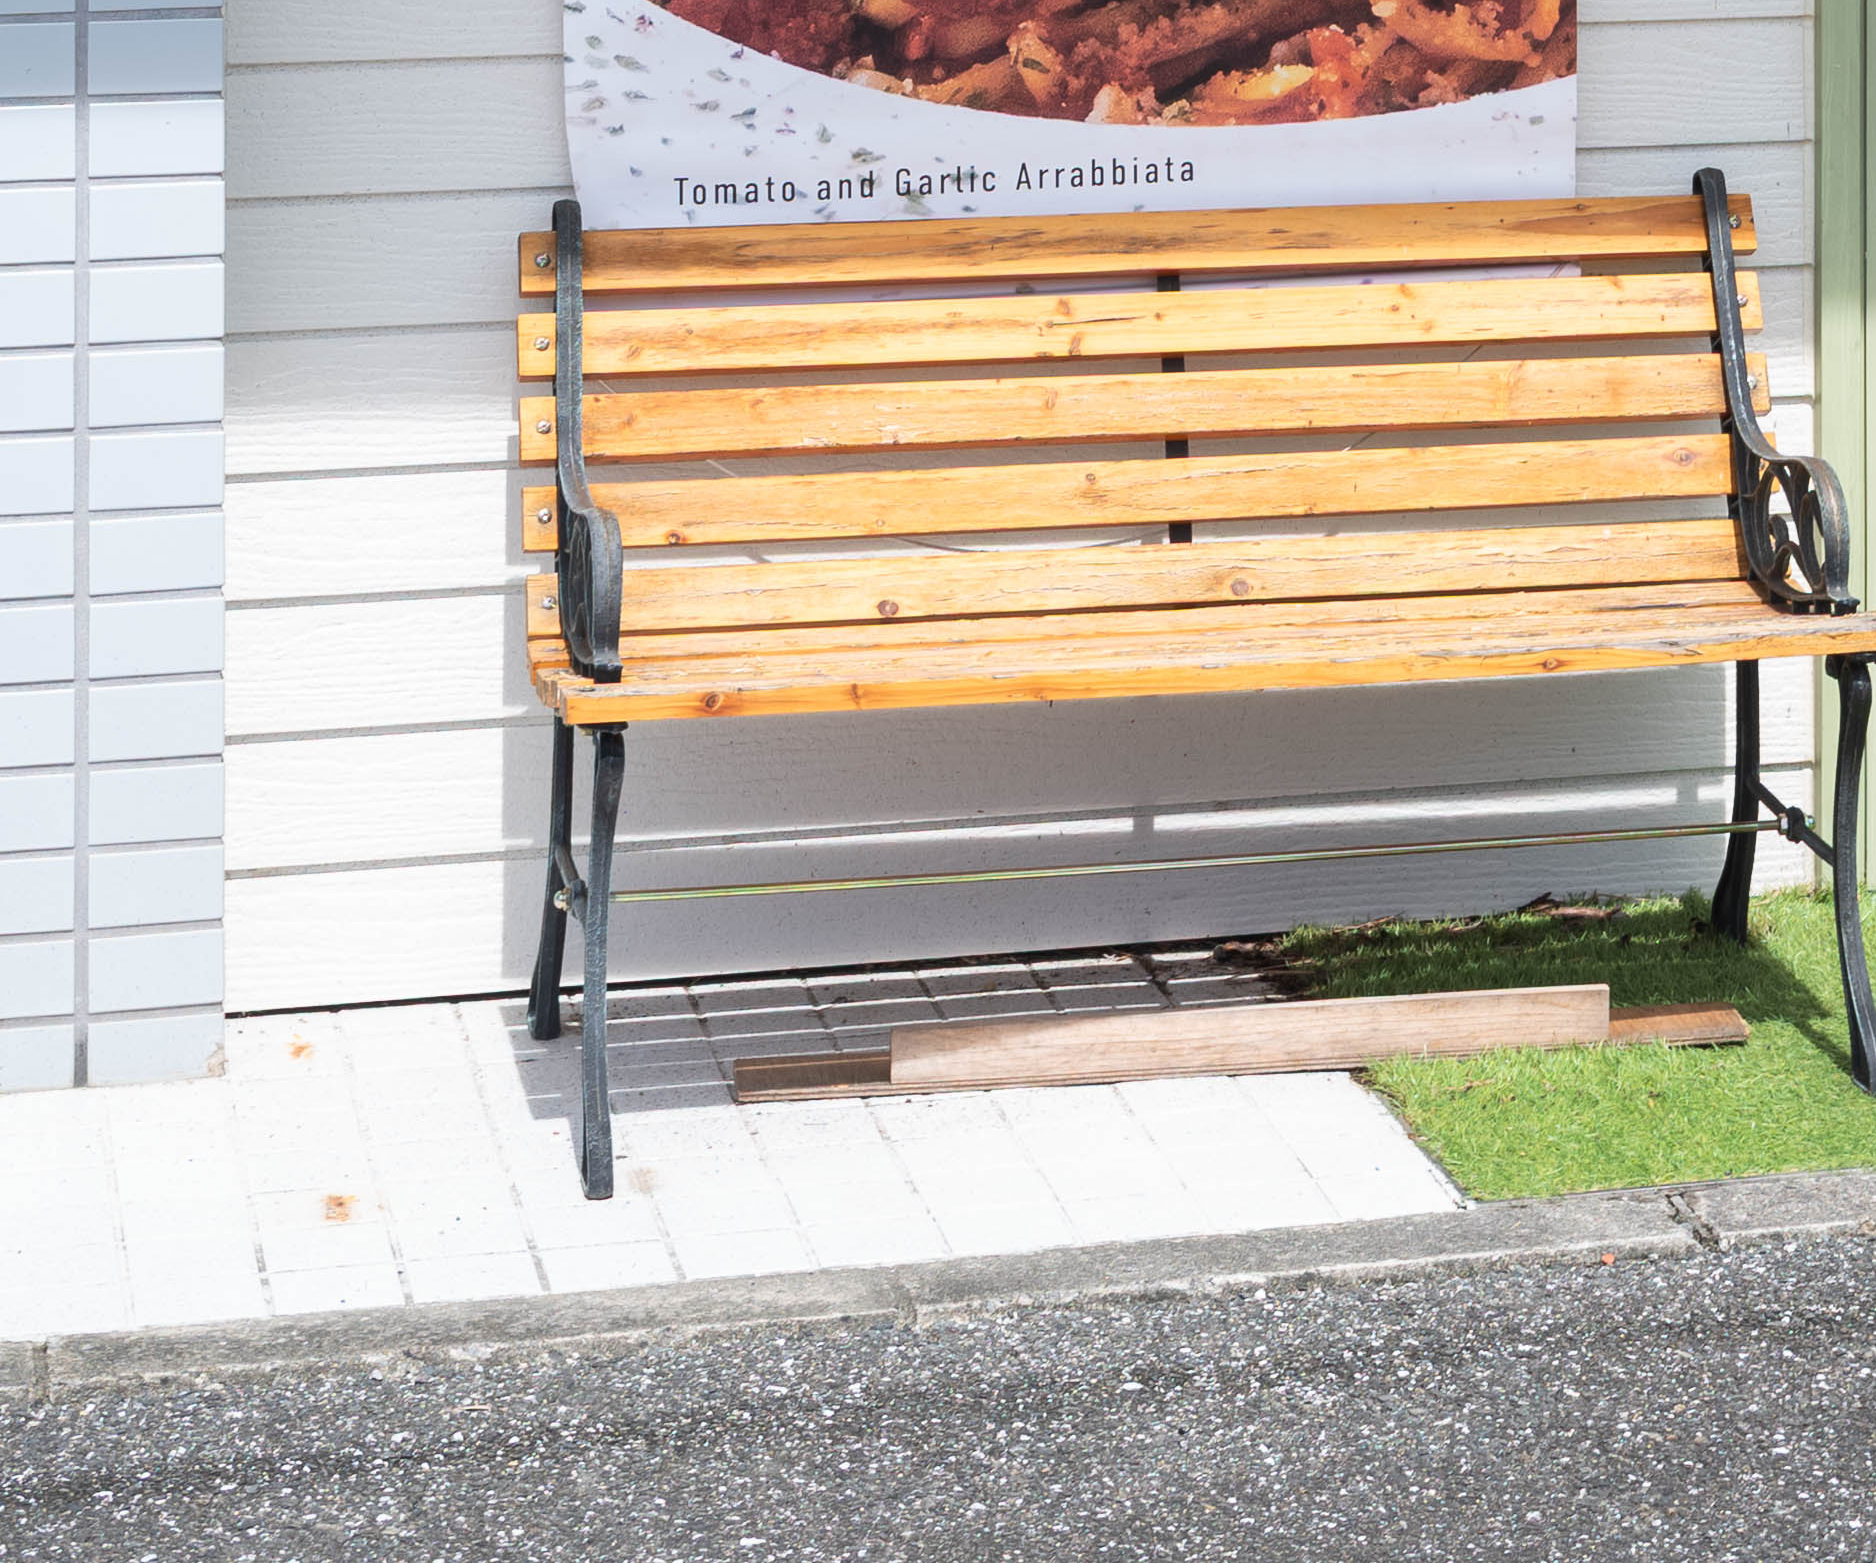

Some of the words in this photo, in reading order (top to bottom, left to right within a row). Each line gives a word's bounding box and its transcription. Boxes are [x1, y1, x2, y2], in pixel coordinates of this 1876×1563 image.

[674, 176, 796, 206] Tomato
[816, 170, 875, 201] and
[895, 165, 997, 196] Garlic
[1016, 156, 1195, 191] Arrabbiata
